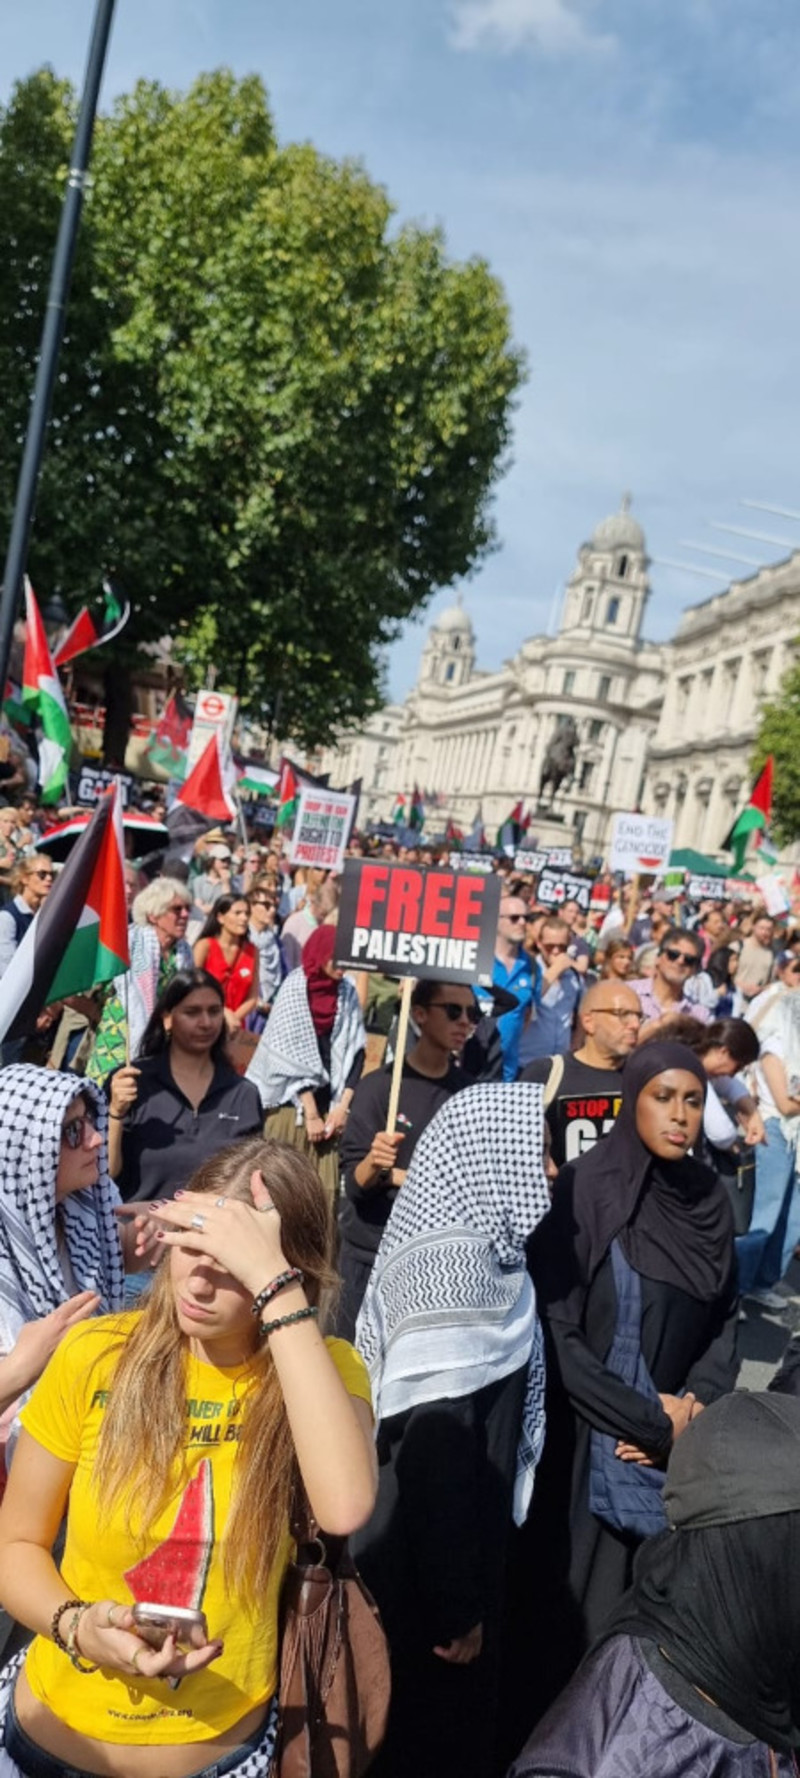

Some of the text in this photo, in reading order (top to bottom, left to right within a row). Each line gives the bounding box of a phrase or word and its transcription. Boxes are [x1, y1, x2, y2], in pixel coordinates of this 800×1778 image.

[294, 843, 340, 864] PROTEST
[355, 864, 485, 940] FREE
[351, 928, 479, 971] PALESTINE
[566, 1099, 609, 1118] STOP
[190, 1423, 221, 1443] WILL
